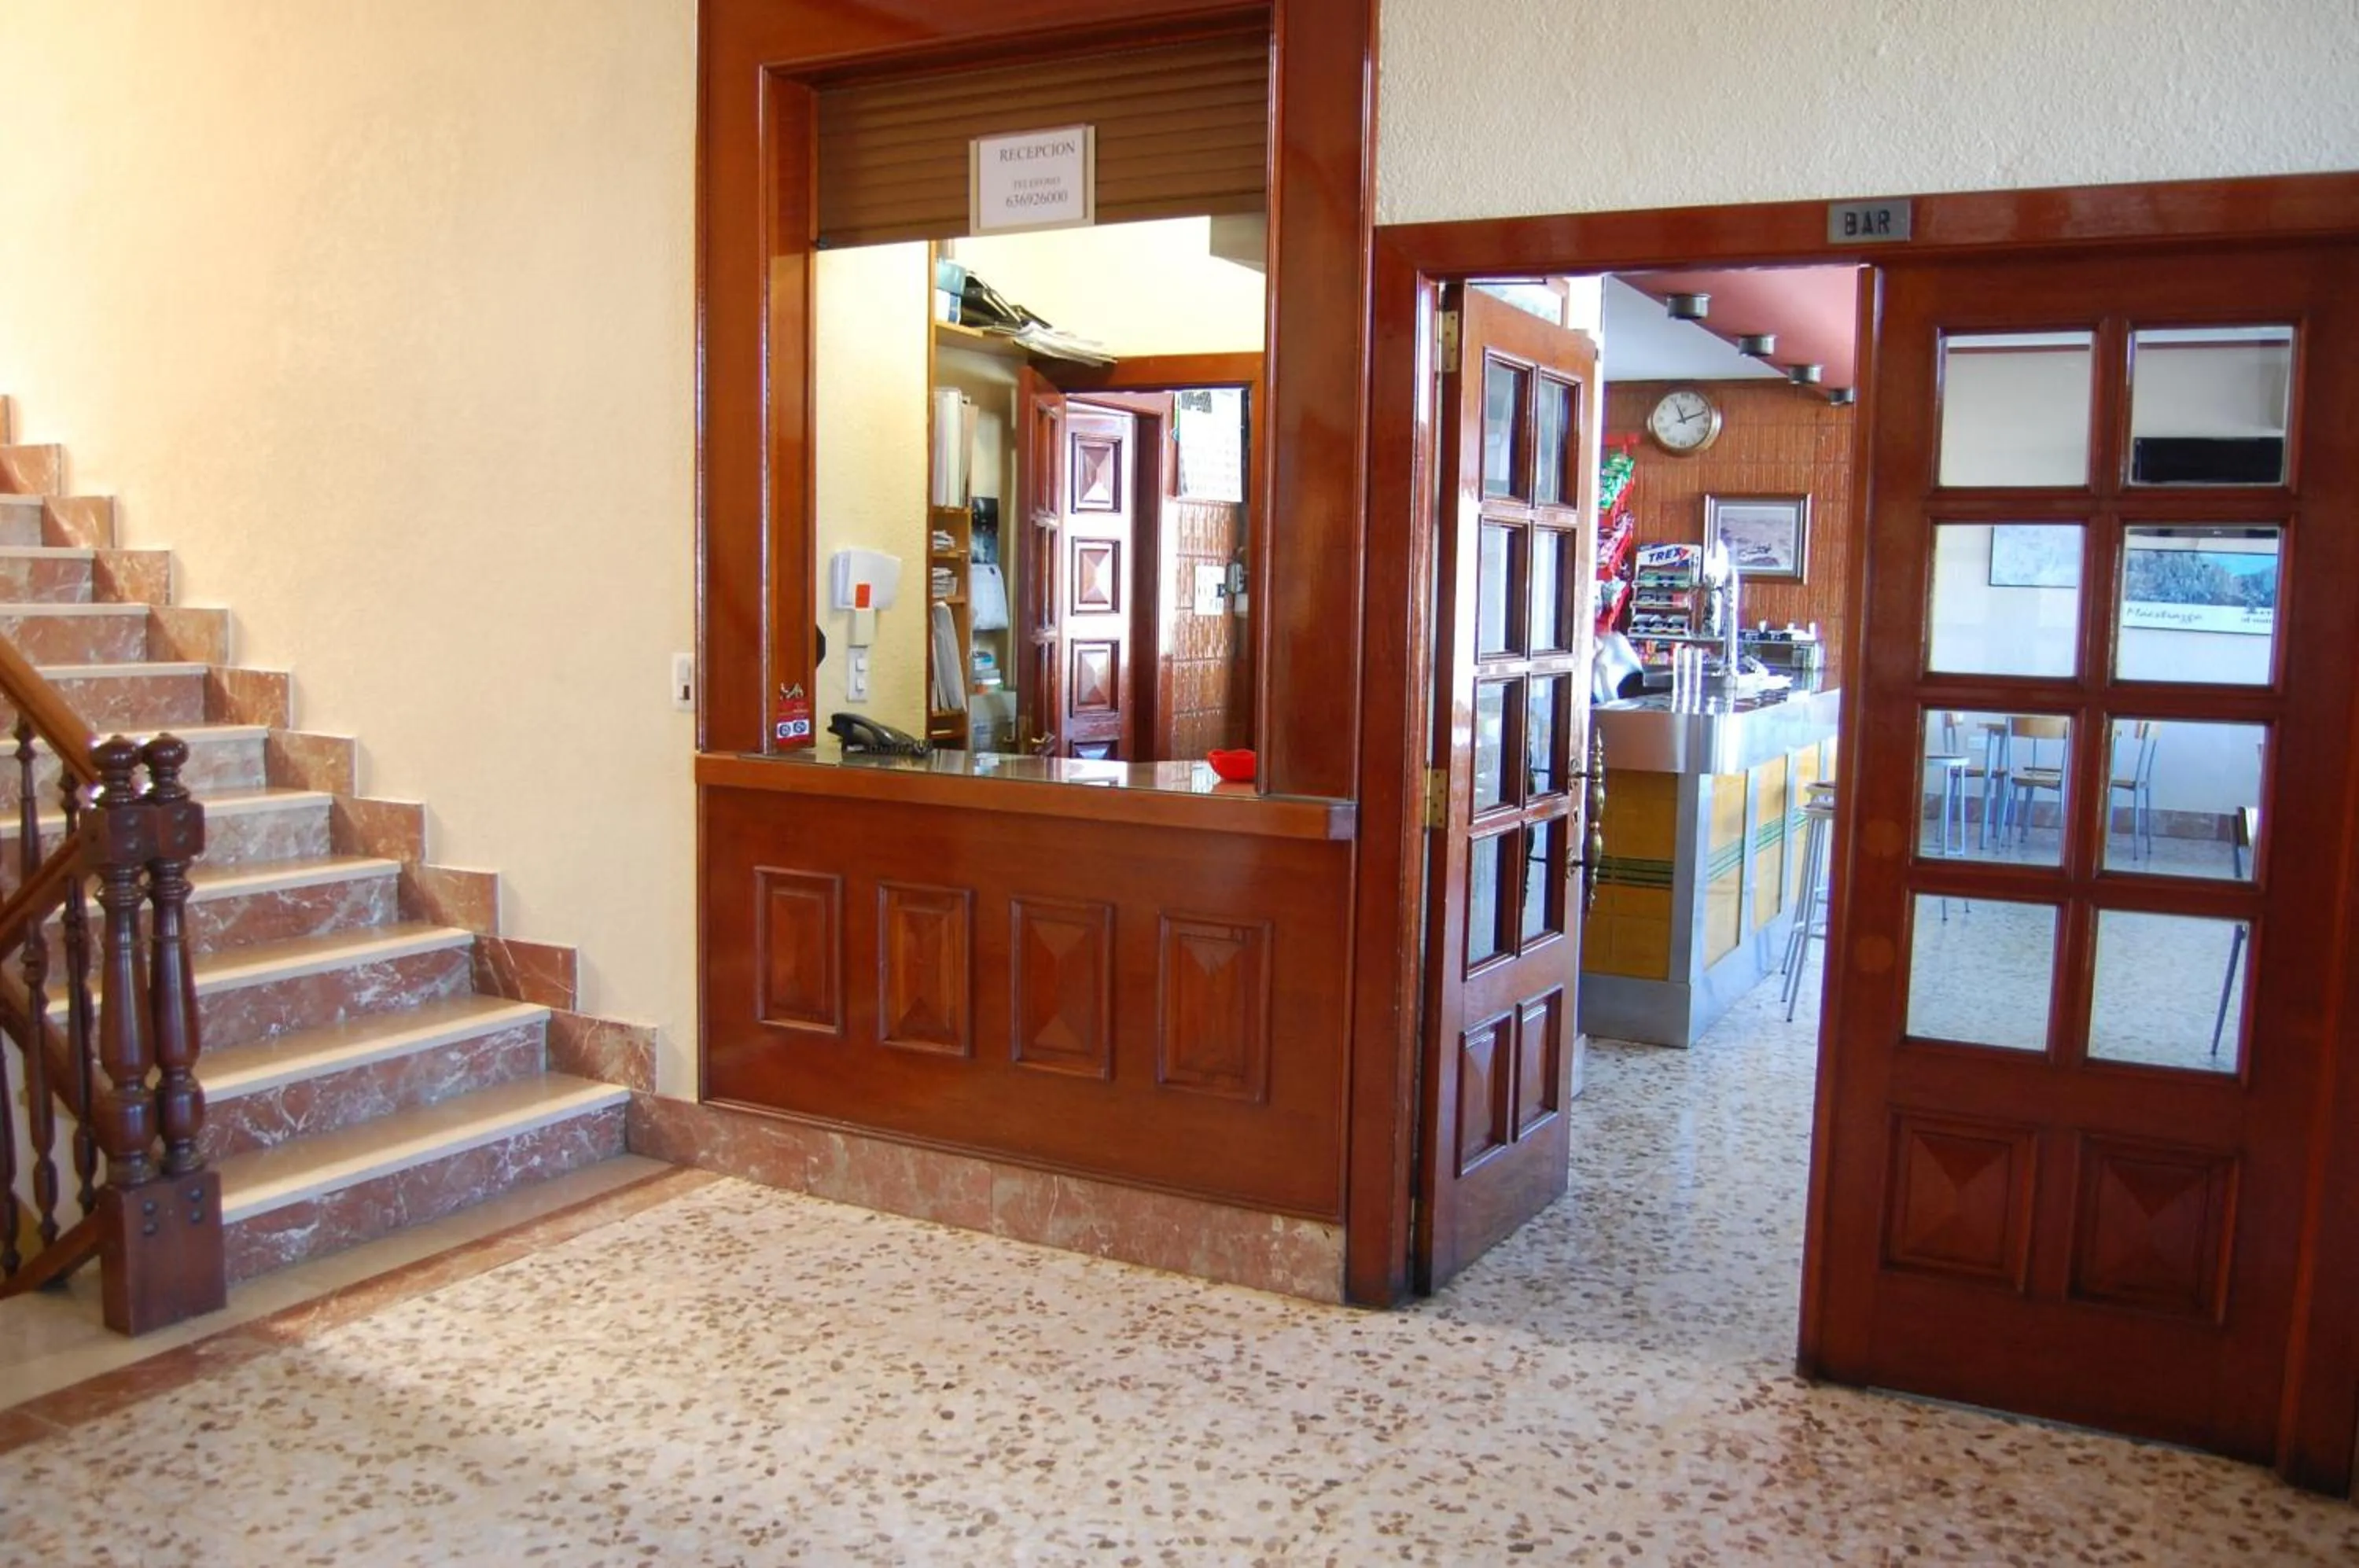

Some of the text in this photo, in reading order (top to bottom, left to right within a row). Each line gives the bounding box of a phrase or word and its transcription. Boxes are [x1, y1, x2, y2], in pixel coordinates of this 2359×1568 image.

[999, 140, 1076, 162] RECEPCION
[1845, 209, 1890, 236] BAR
[1648, 547, 1682, 562] TREX
